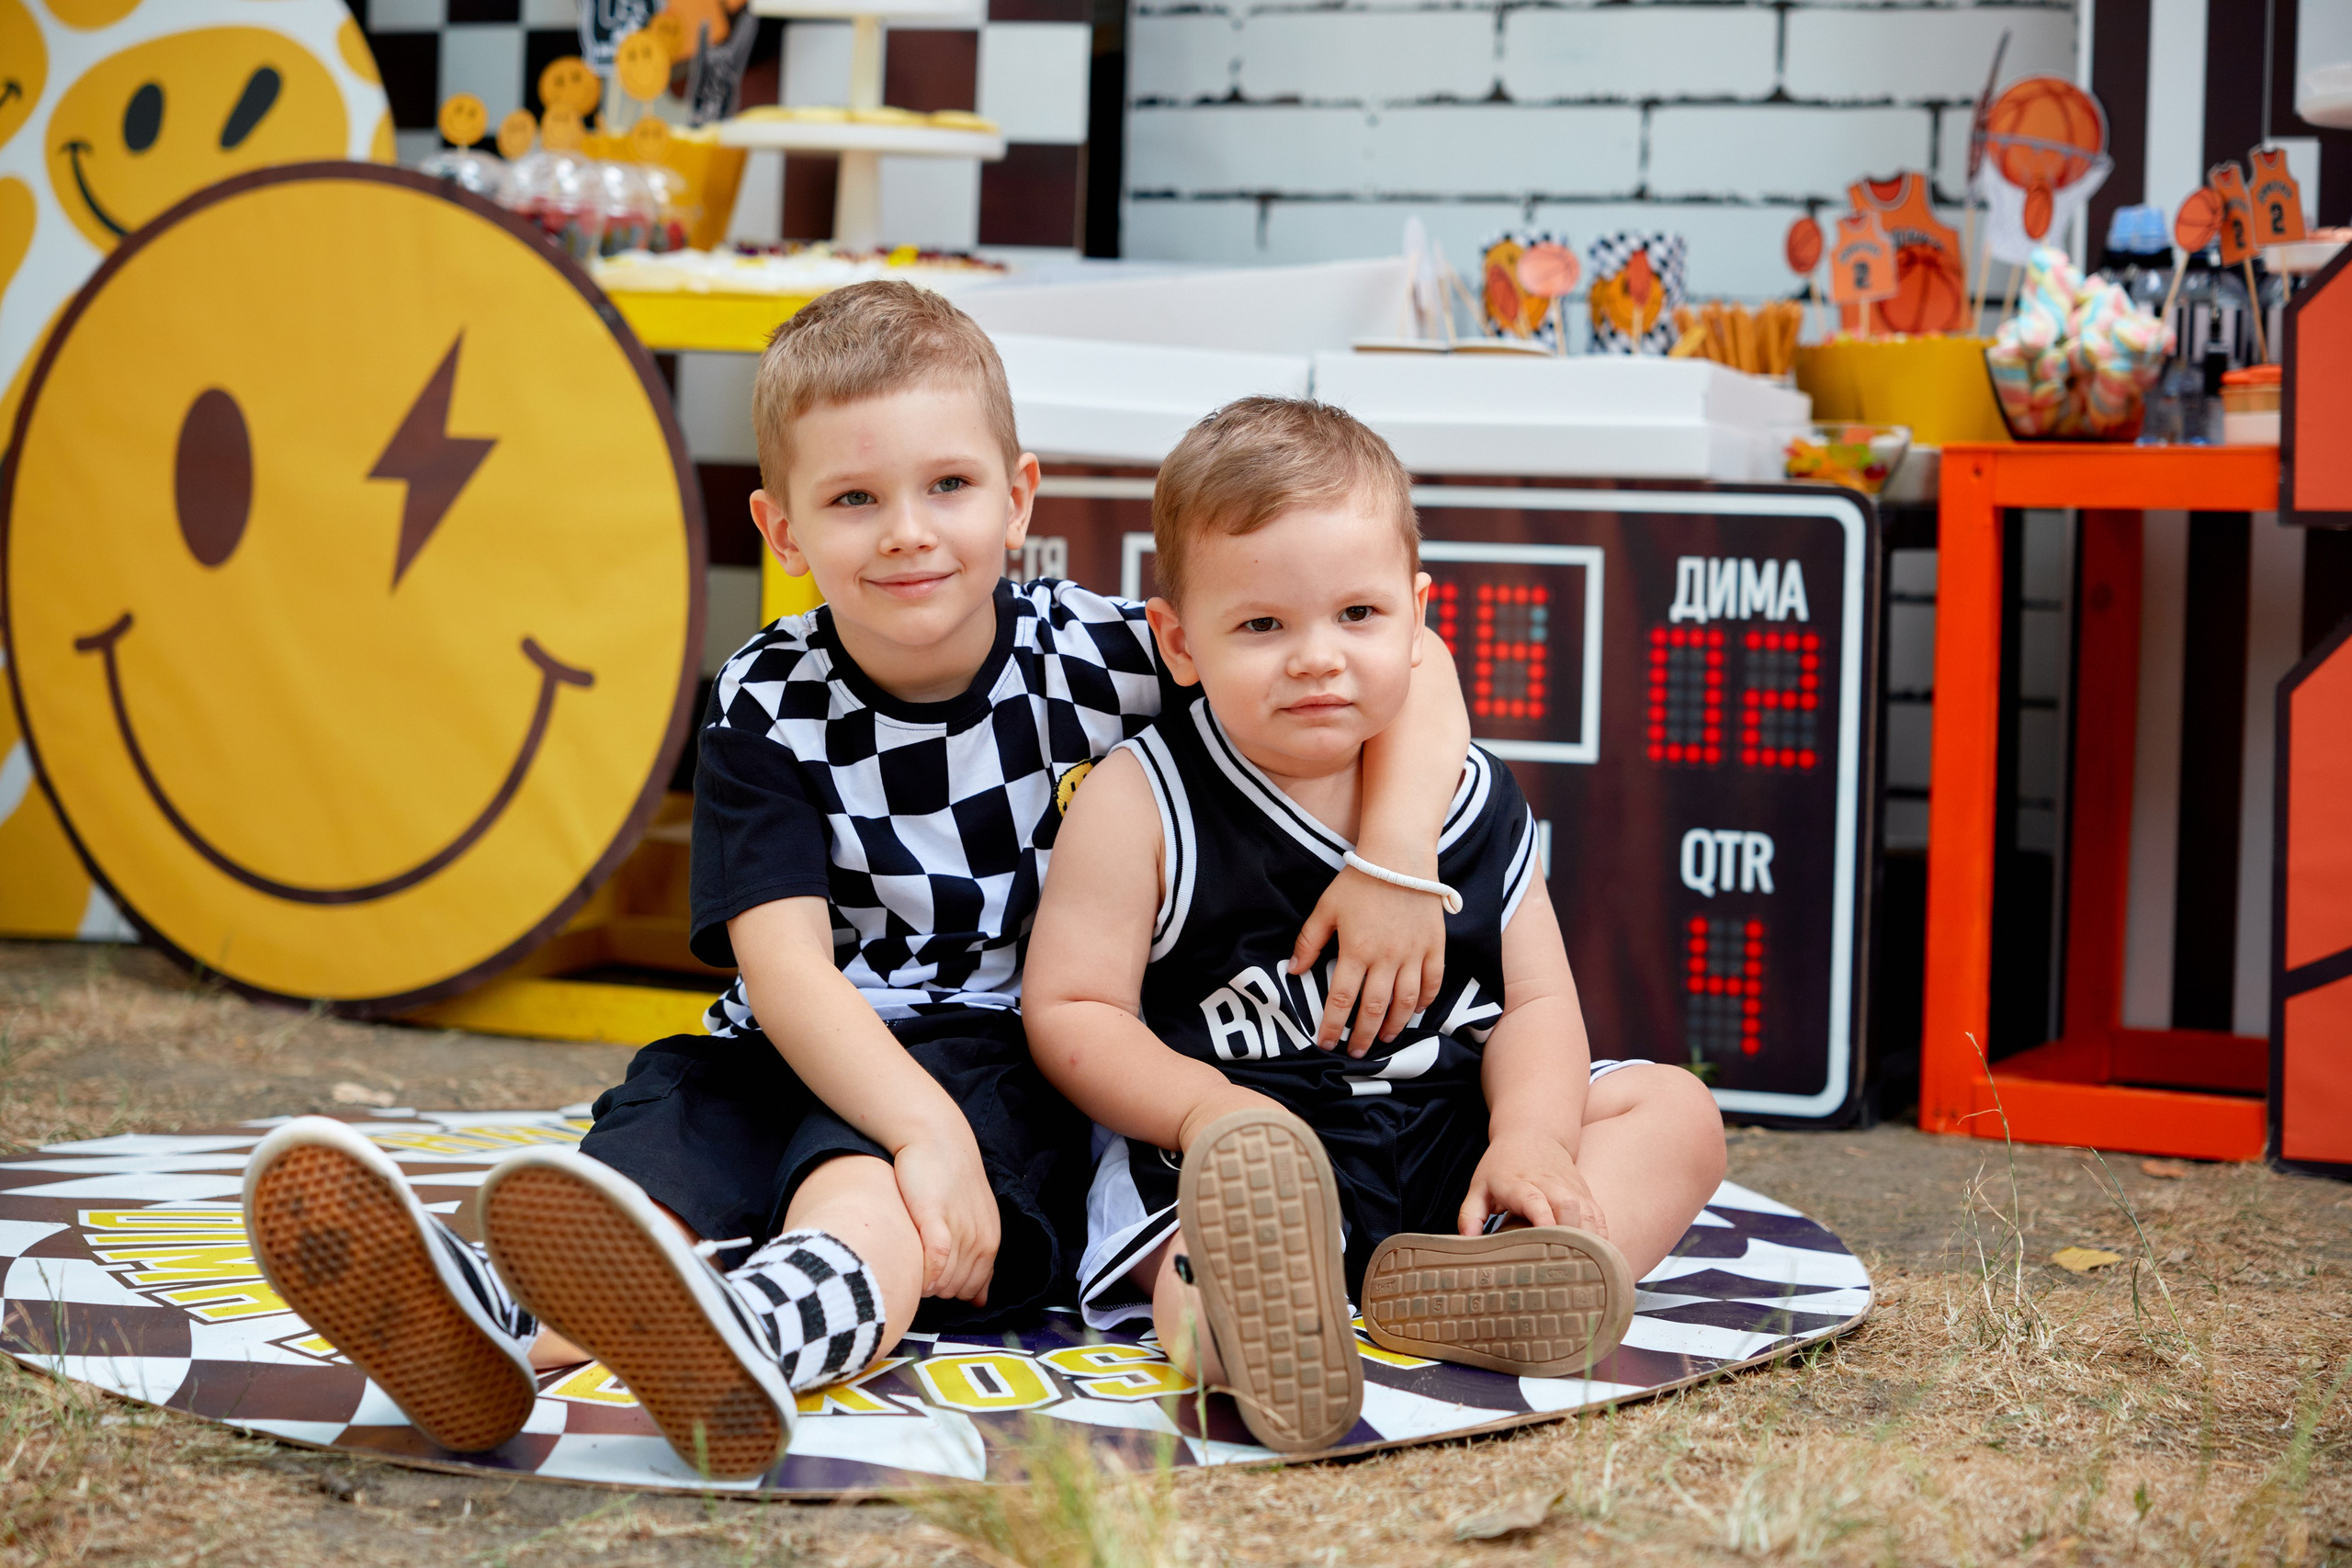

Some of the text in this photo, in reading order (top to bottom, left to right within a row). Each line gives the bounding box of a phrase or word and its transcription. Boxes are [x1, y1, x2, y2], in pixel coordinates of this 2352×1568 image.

[2269, 203, 2285, 235] 2
[1668, 555, 1810, 625] ДИМА
[1647, 626, 1820, 770] 02
[1679, 827, 1776, 898] QTR
[1686, 916, 1765, 1055] 4
